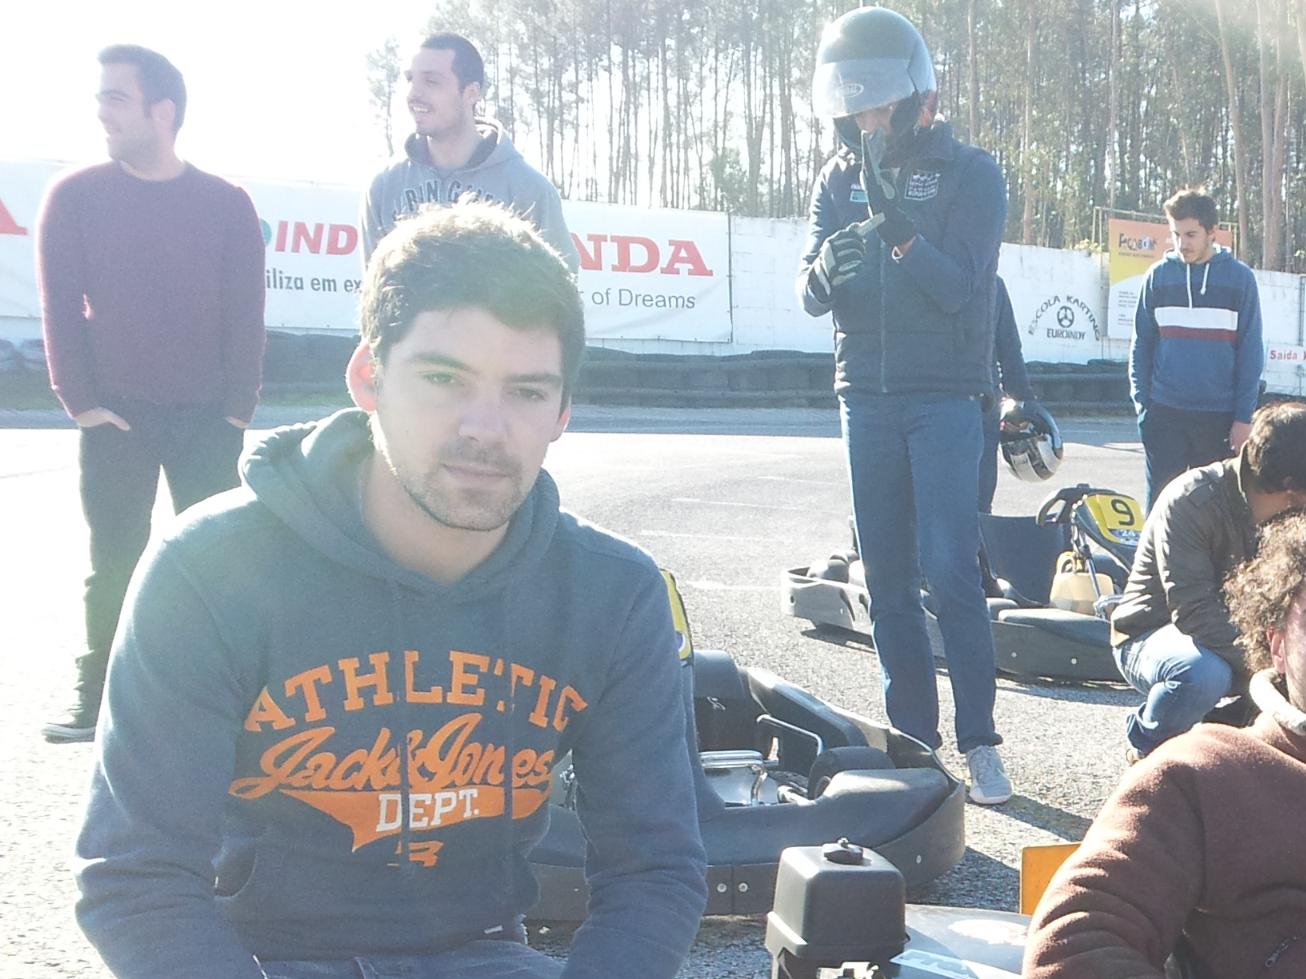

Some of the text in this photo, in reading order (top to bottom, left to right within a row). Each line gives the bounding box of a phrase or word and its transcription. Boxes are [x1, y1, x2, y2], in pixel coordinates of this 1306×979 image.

[274, 220, 359, 256] IND
[569, 232, 714, 277] NDA
[265, 267, 362, 293] iliza em ex
[591, 287, 697, 309] of Dreams
[1028, 295, 1061, 336] ESCOLA
[1066, 295, 1101, 342] KARTING
[1110, 498, 1136, 526] 9
[244, 650, 588, 733] ATHLETIC
